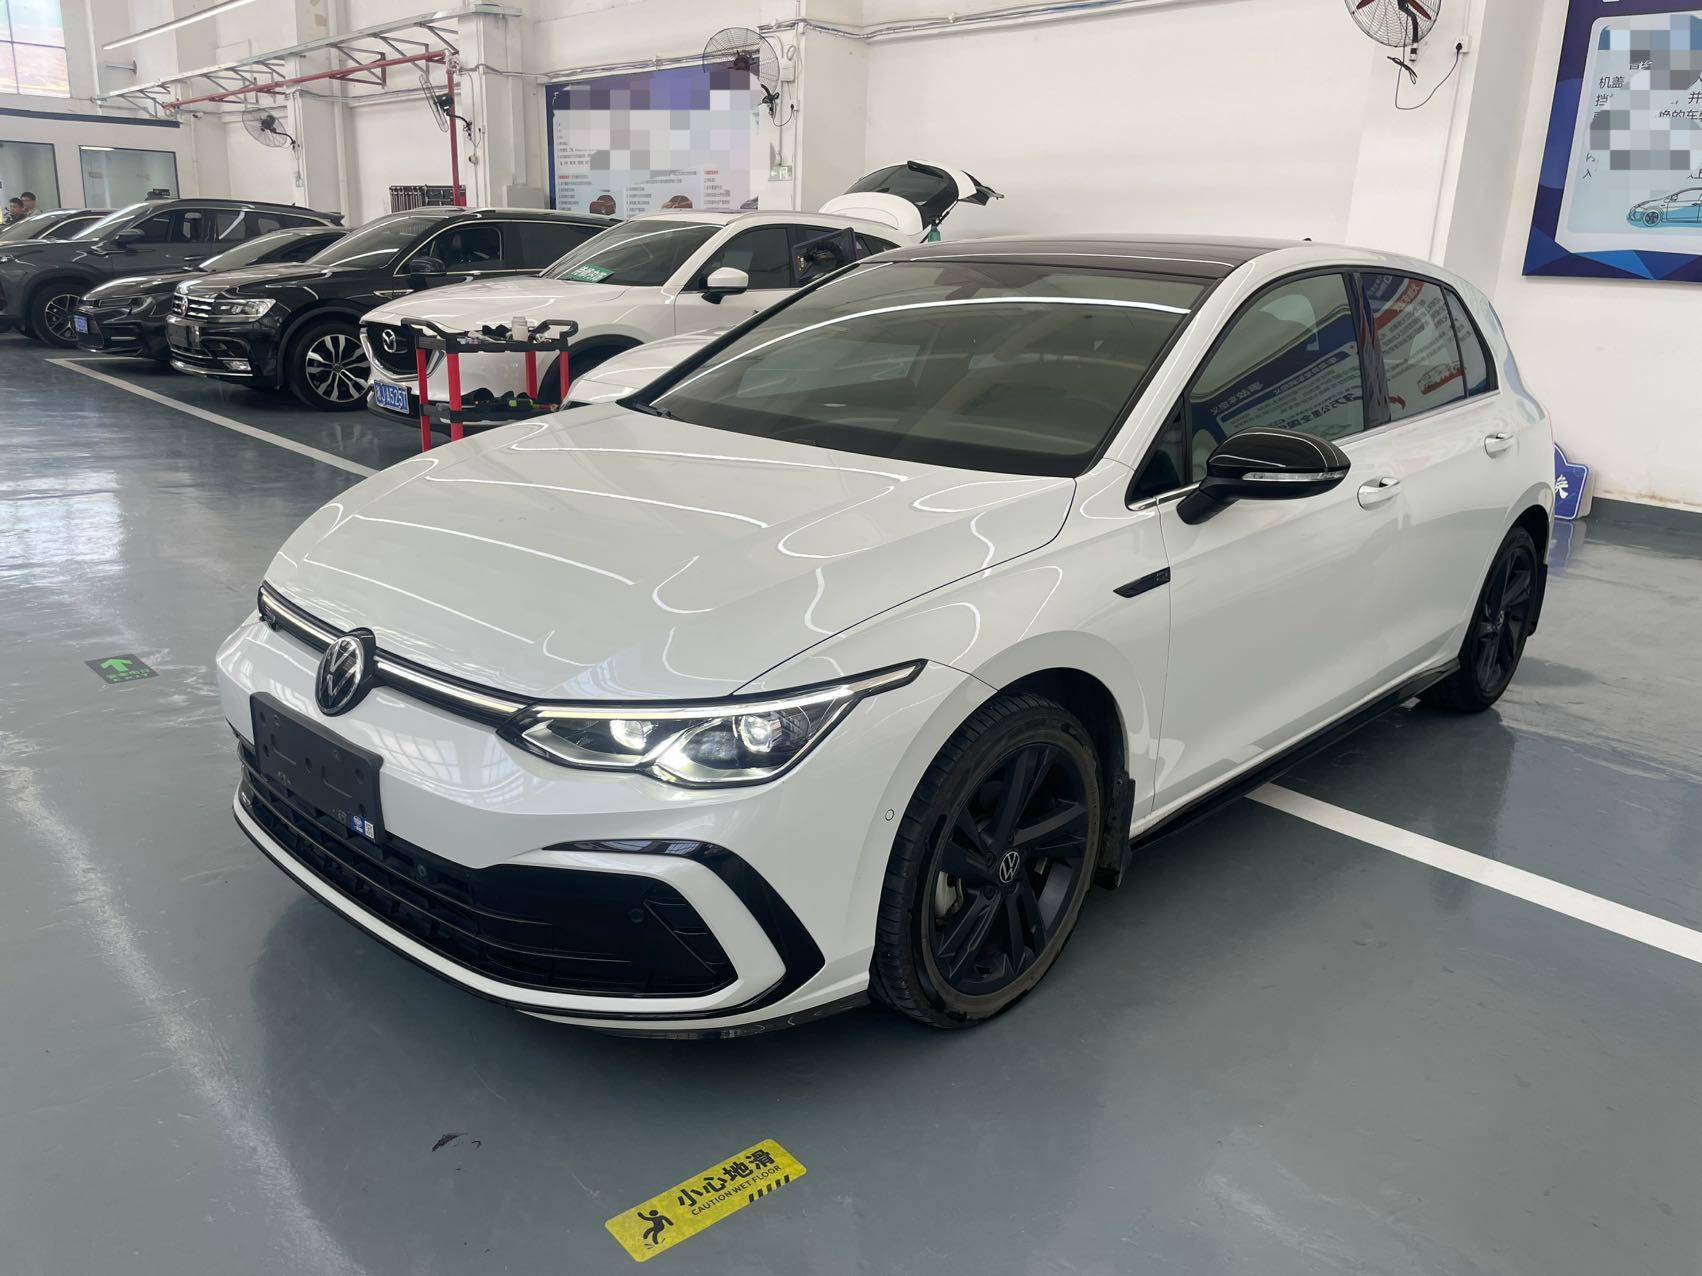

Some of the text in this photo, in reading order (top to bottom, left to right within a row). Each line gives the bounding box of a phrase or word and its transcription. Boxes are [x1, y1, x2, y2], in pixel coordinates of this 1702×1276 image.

[1600, 77, 1624, 89] 机盖
[677, 1149, 776, 1207] 小心地滑
[691, 1165, 782, 1216] CAUTION WET FLOOR
